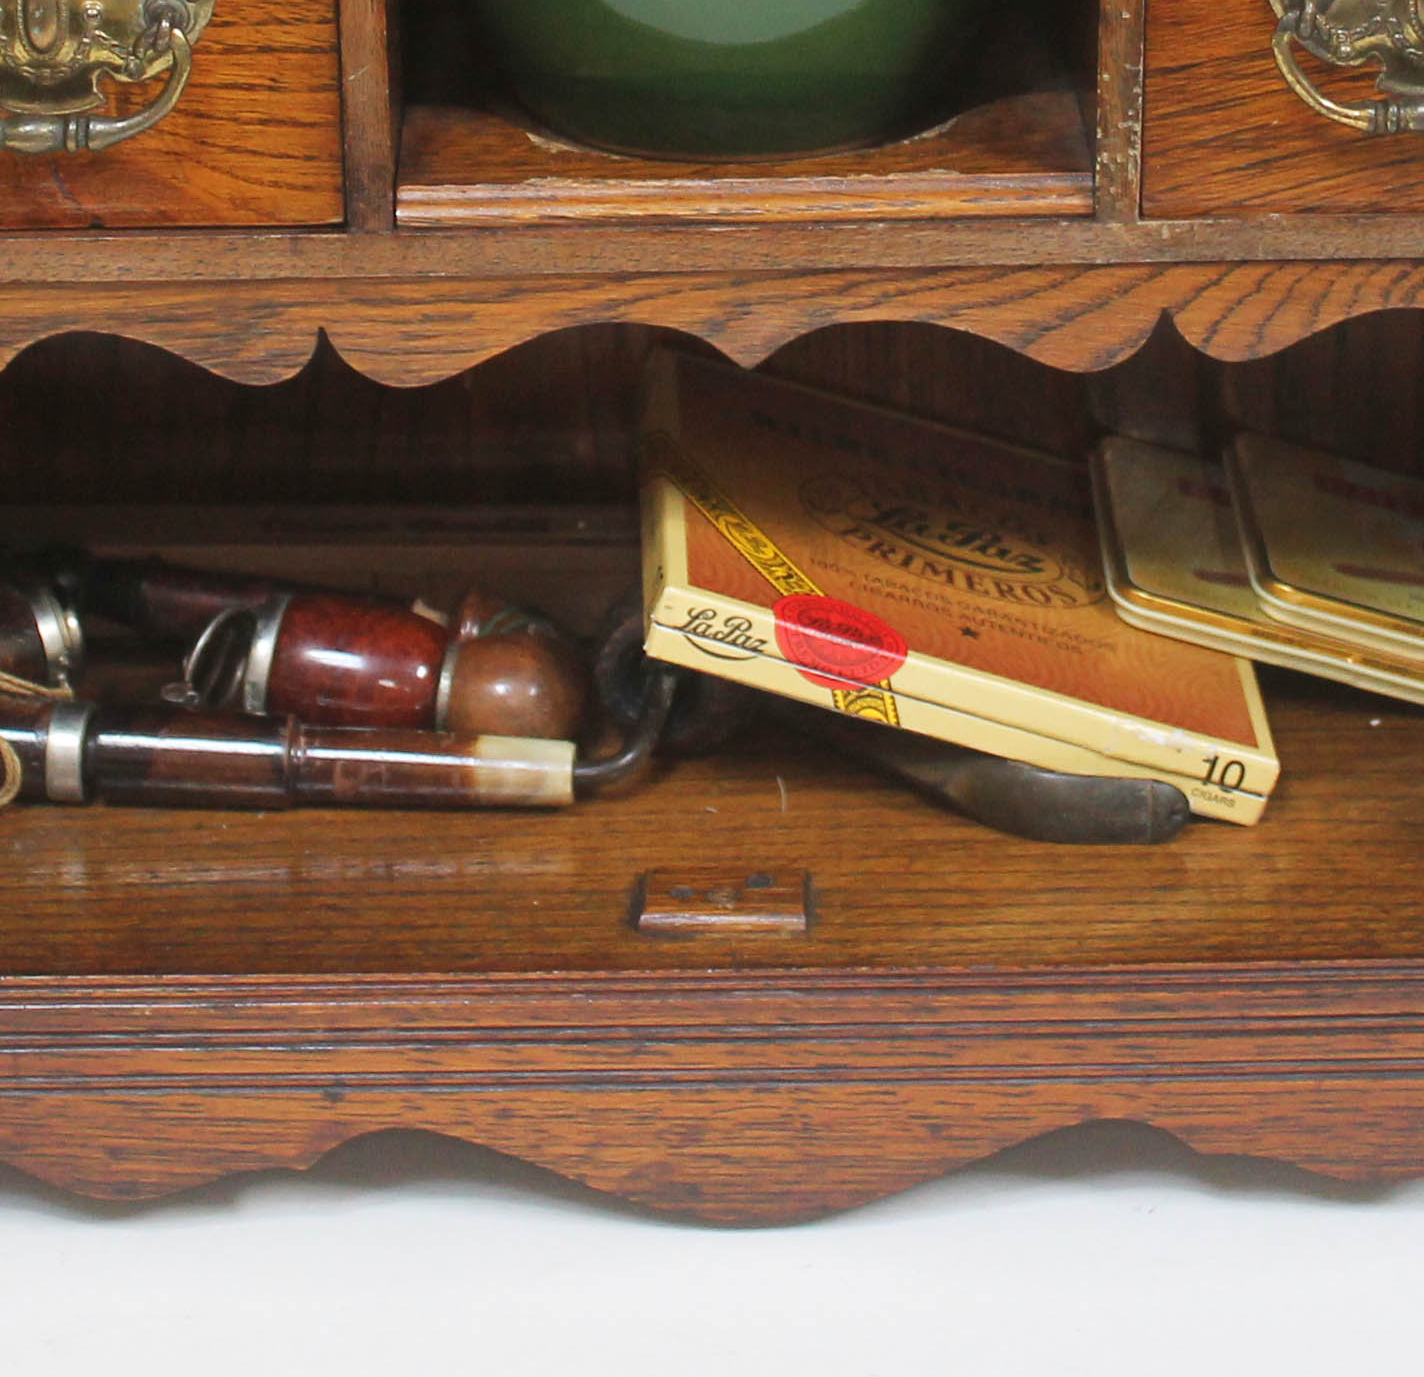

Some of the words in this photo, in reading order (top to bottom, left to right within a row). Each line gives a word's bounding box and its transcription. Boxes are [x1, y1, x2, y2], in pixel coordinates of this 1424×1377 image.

[840, 526, 1078, 607] PRIMEROS
[935, 520, 1043, 575] Paz
[849, 581, 953, 619] CIGARROS
[680, 607, 717, 636] La
[713, 616, 768, 653] Paz
[1202, 755, 1245, 793] 10
[1191, 788, 1235, 808] CIGARS
